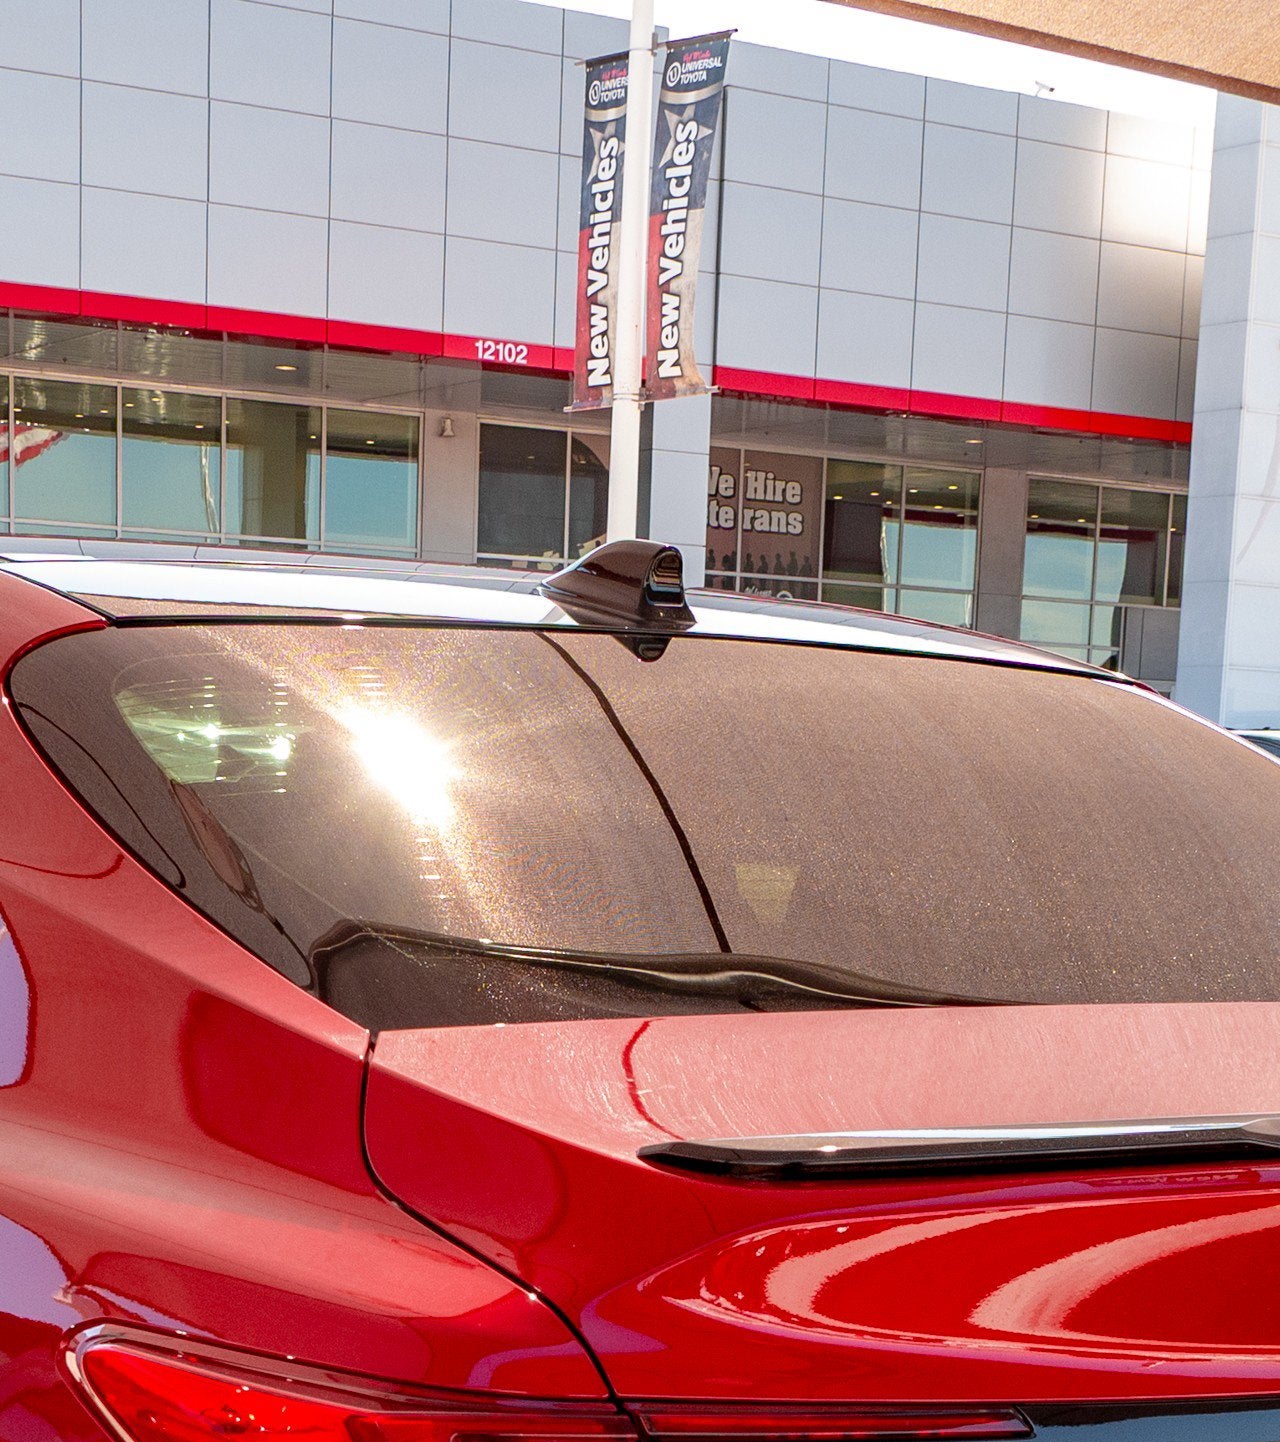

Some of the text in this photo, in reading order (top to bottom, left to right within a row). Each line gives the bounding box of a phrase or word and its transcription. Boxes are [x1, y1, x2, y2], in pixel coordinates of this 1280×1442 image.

[680, 70, 707, 84] TOYOTA
[681, 56, 723, 74] UNIVERSAL
[600, 88, 626, 103] TOYOTA
[586, 136, 619, 388] New Vehicles
[656, 120, 699, 379] New Vehicles
[475, 339, 528, 364] 12102
[746, 470, 802, 504] Hire
